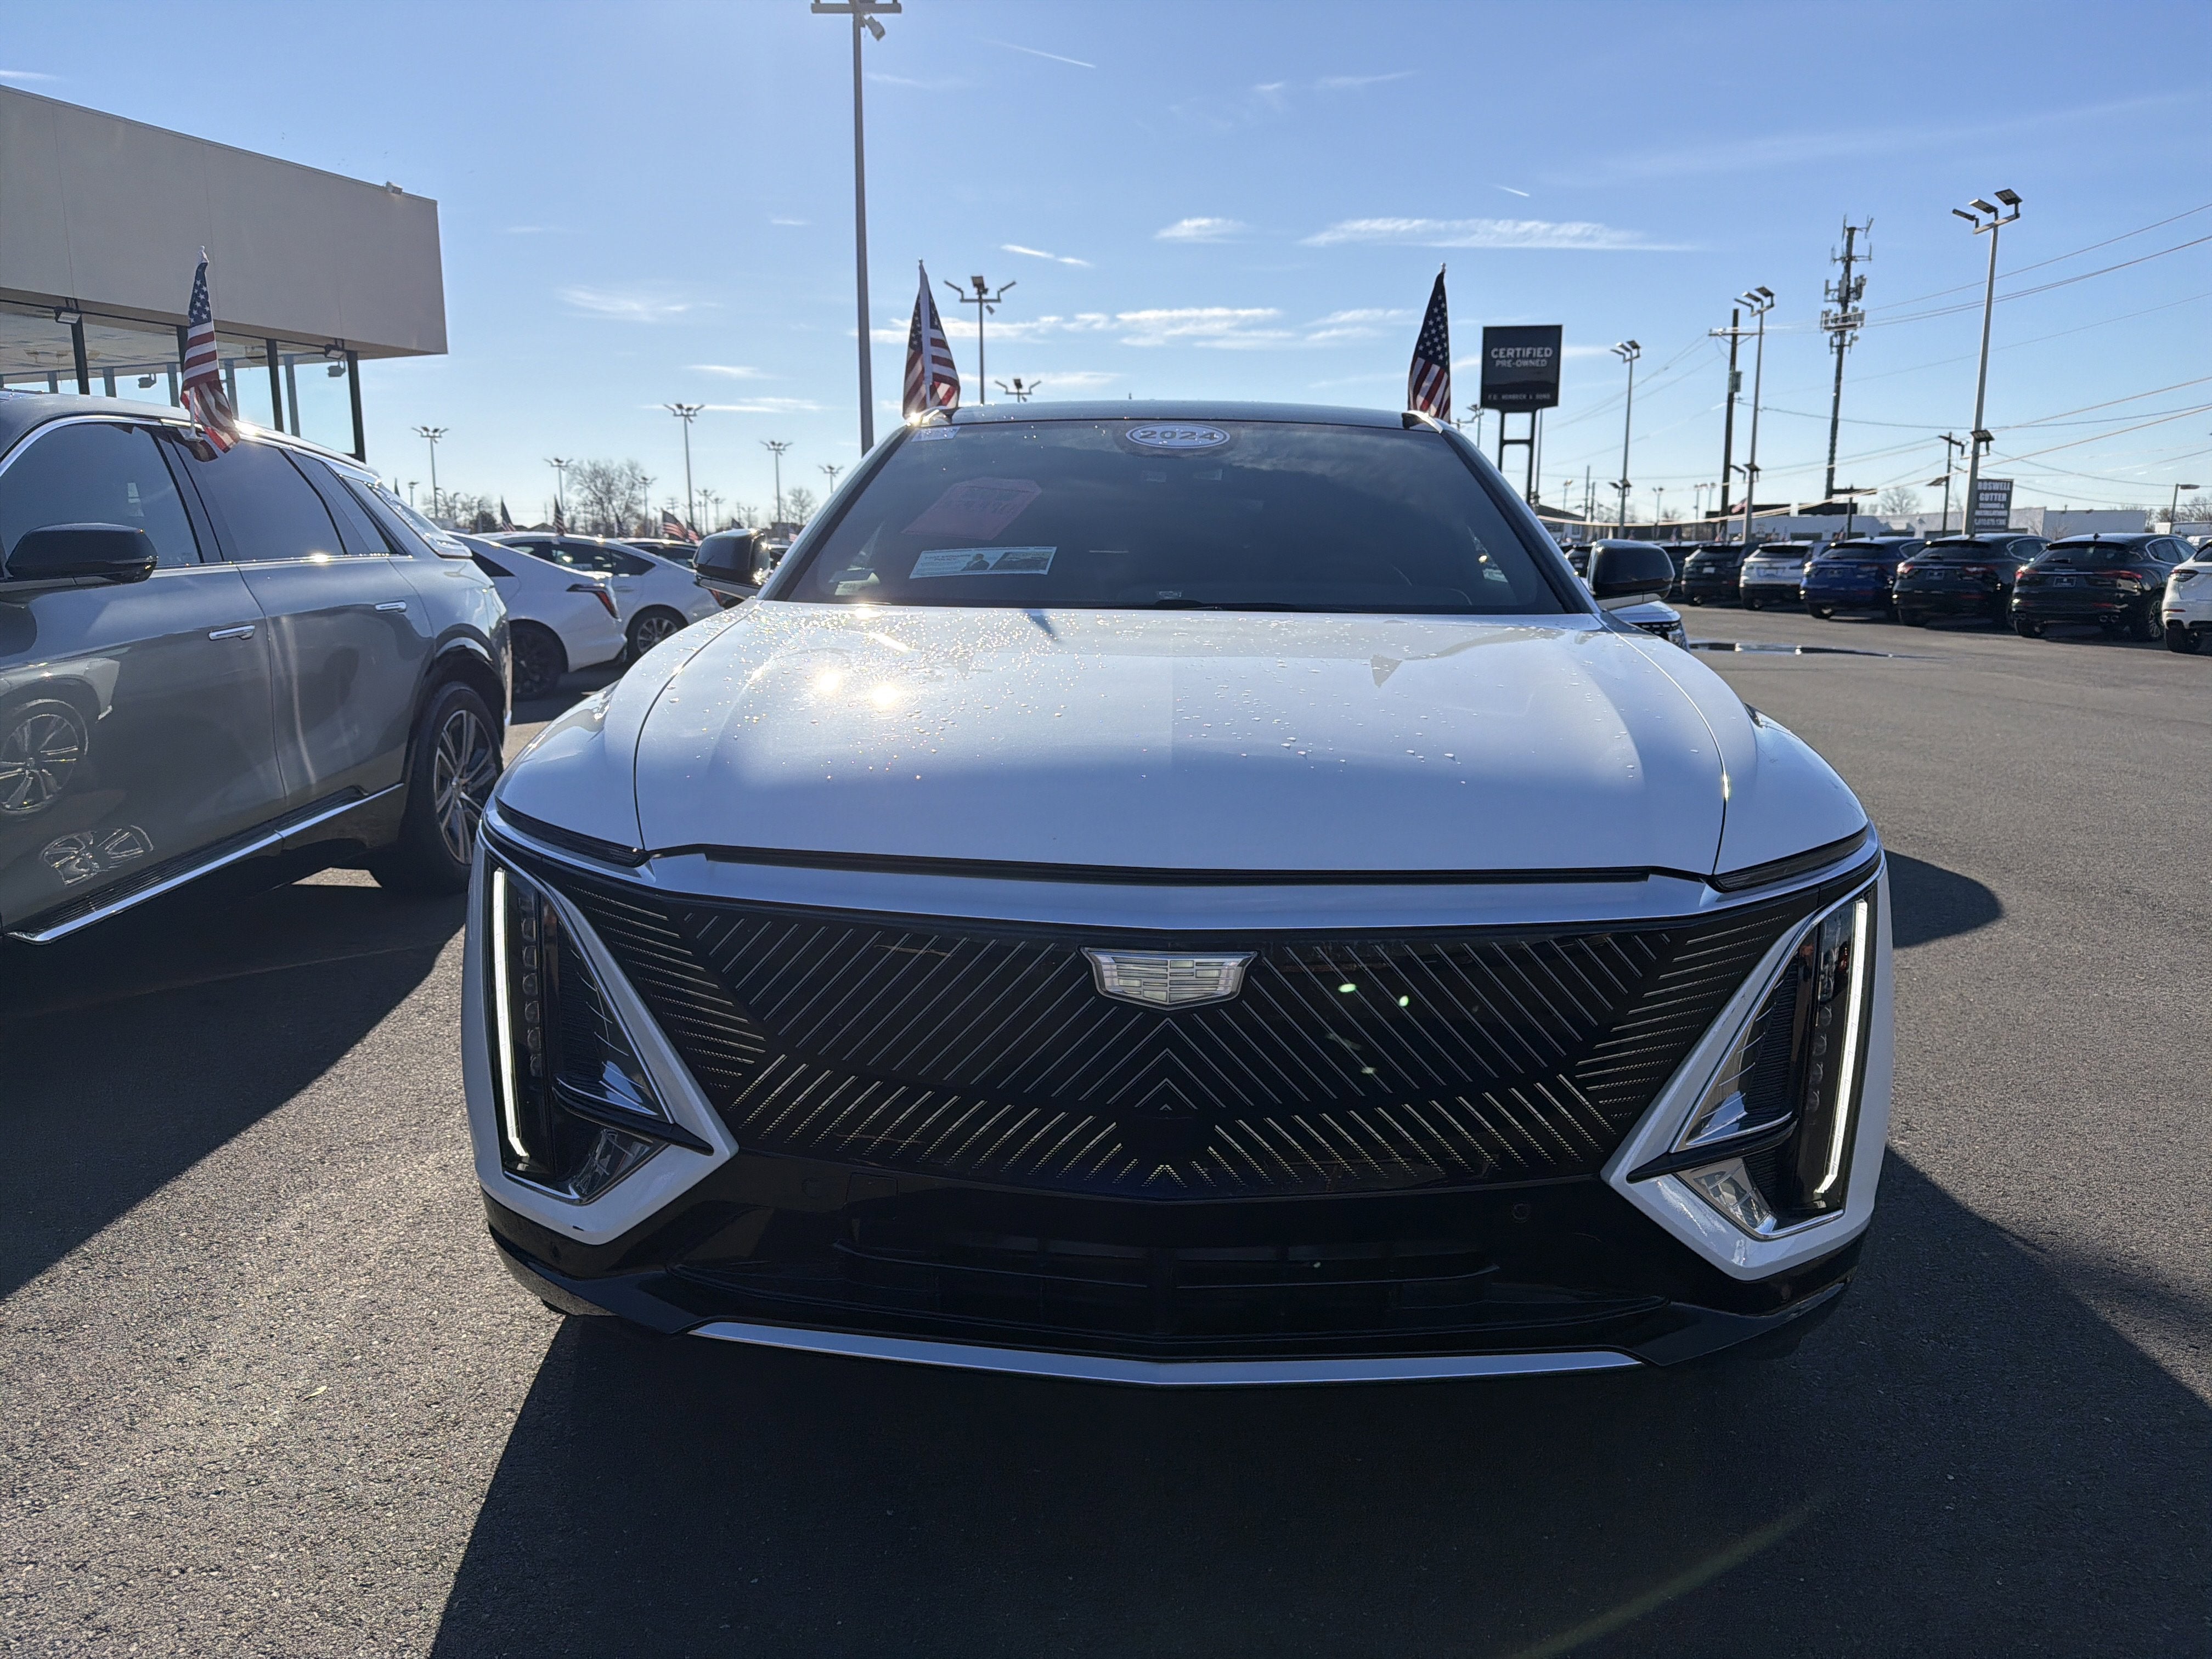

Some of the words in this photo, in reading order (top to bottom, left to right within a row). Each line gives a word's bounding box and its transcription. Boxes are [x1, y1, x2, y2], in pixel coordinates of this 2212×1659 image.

[1491, 347, 1553, 358] CERTIFIED
[1496, 359, 1548, 368] PRE-OWNED
[1139, 430, 1220, 441] 2024
[1979, 493, 2007, 501] GUTTER
